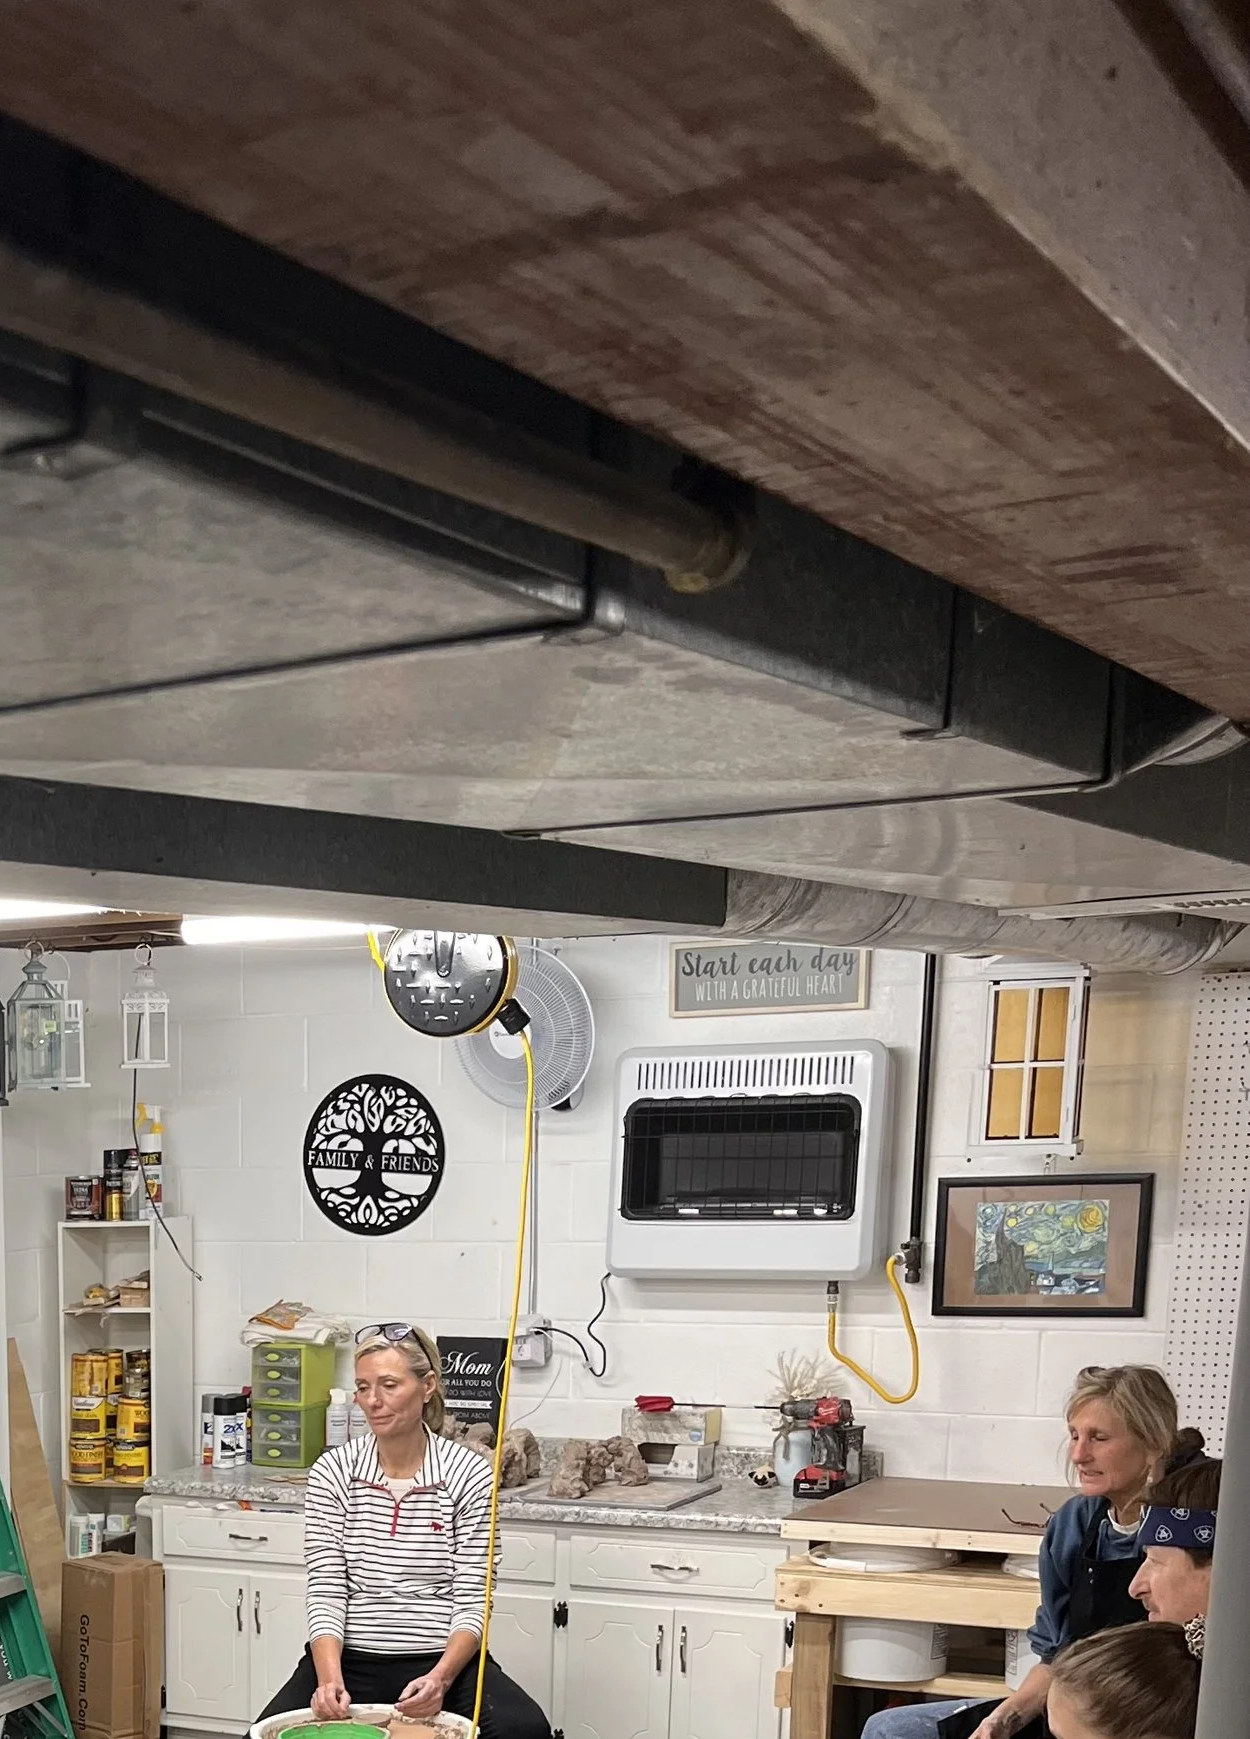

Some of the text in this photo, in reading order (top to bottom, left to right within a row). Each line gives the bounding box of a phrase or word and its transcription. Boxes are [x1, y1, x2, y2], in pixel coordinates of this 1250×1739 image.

[682, 947, 857, 978] Start each day
[695, 973, 843, 1001] WITH A GRATEFUL HEART
[308, 1150, 439, 1172] FAMILY & FRIENDS
[441, 1351, 494, 1375] Mom
[451, 1379, 464, 1387] ALL
